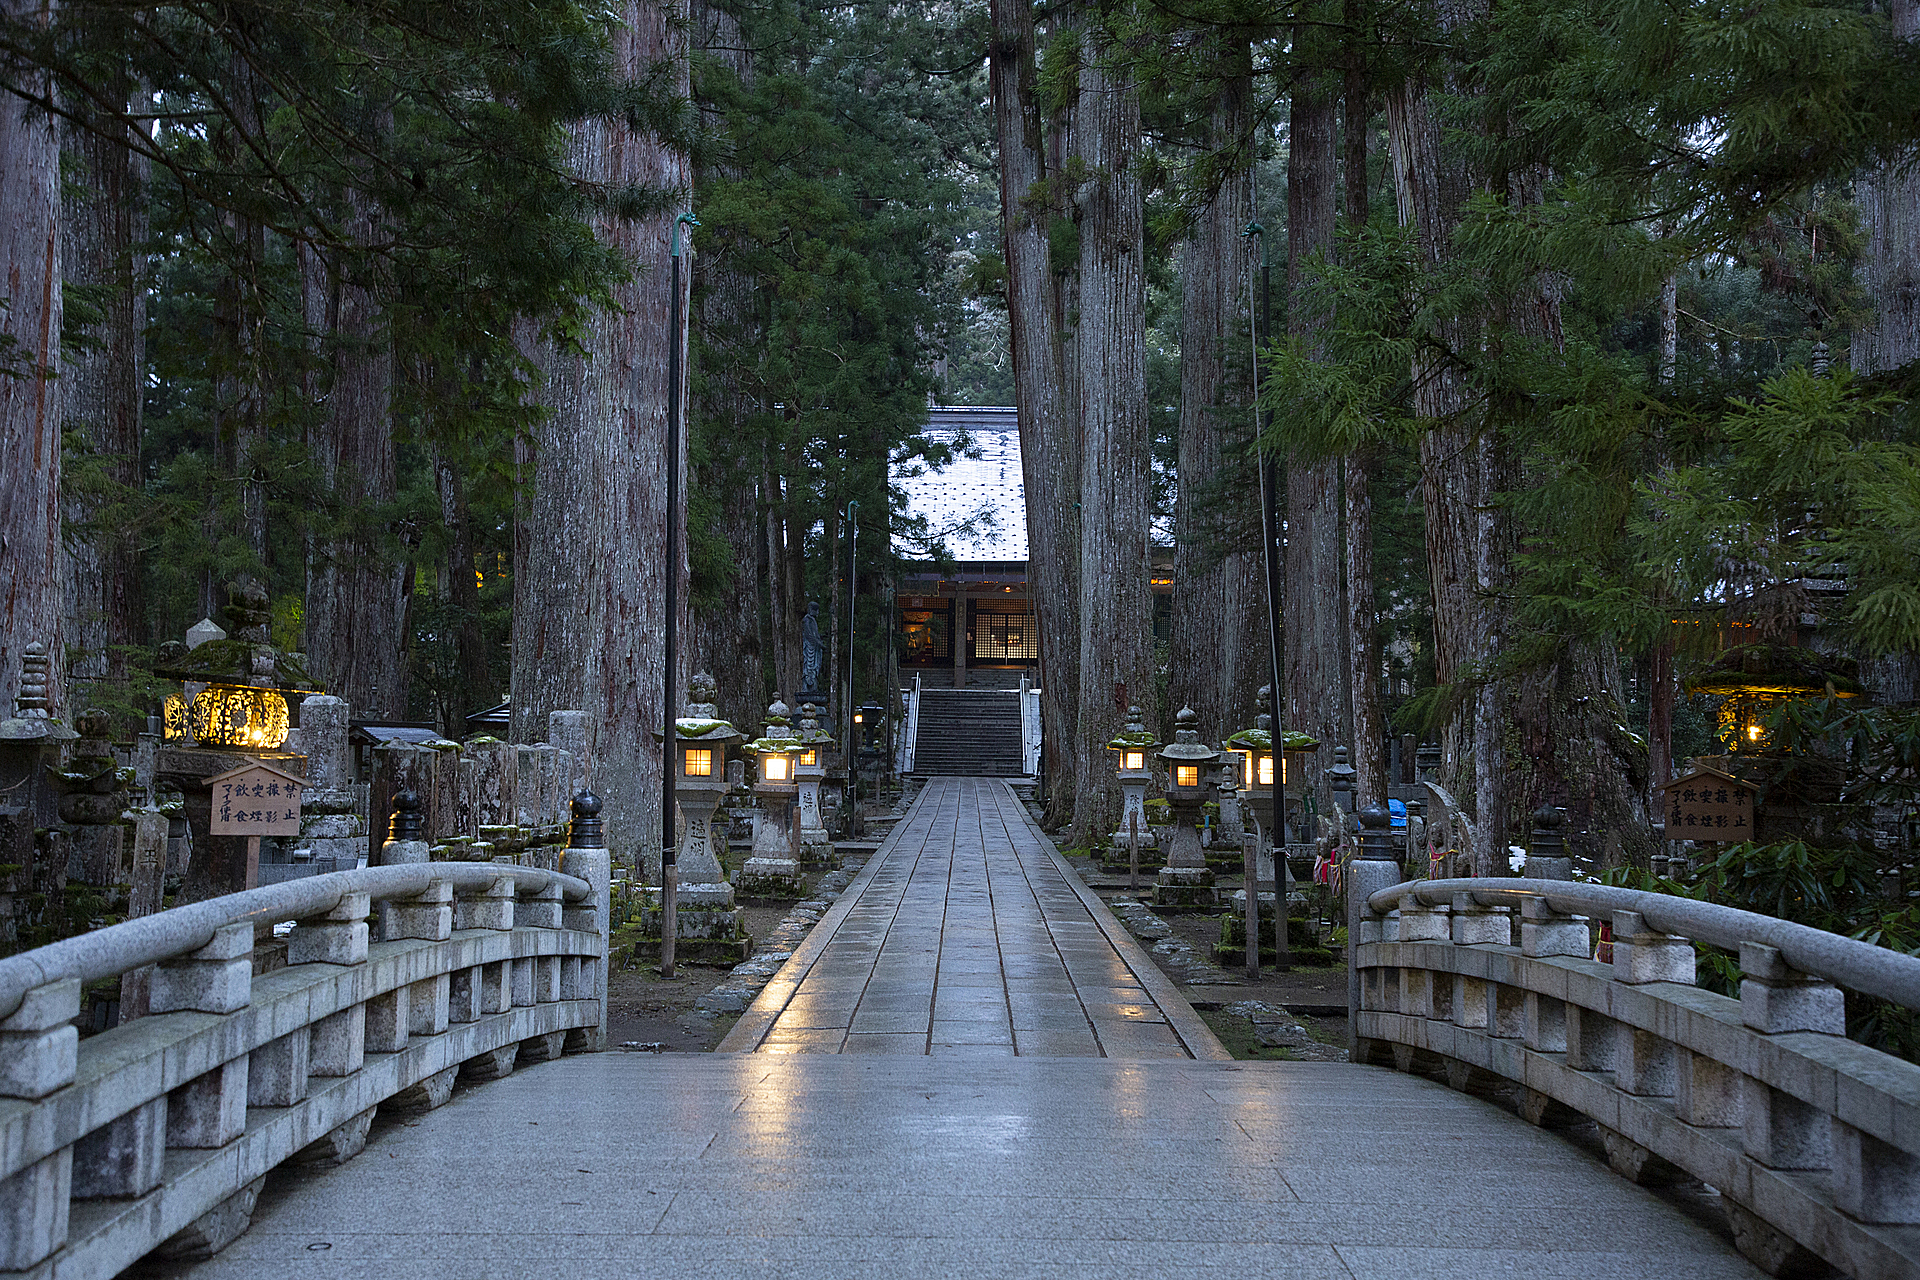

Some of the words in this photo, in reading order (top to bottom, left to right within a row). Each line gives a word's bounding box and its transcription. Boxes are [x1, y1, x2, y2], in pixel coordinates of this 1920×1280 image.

[233, 783, 250, 823] 飲食
[249, 783, 264, 823] 喫煙
[265, 782, 280, 823] 撮影
[283, 782, 298, 821] 禁止
[1682, 788, 1698, 827] 飲食
[1699, 788, 1713, 828] 喫煙
[1714, 788, 1729, 828] 撮影
[1732, 787, 1748, 828] 禁止
